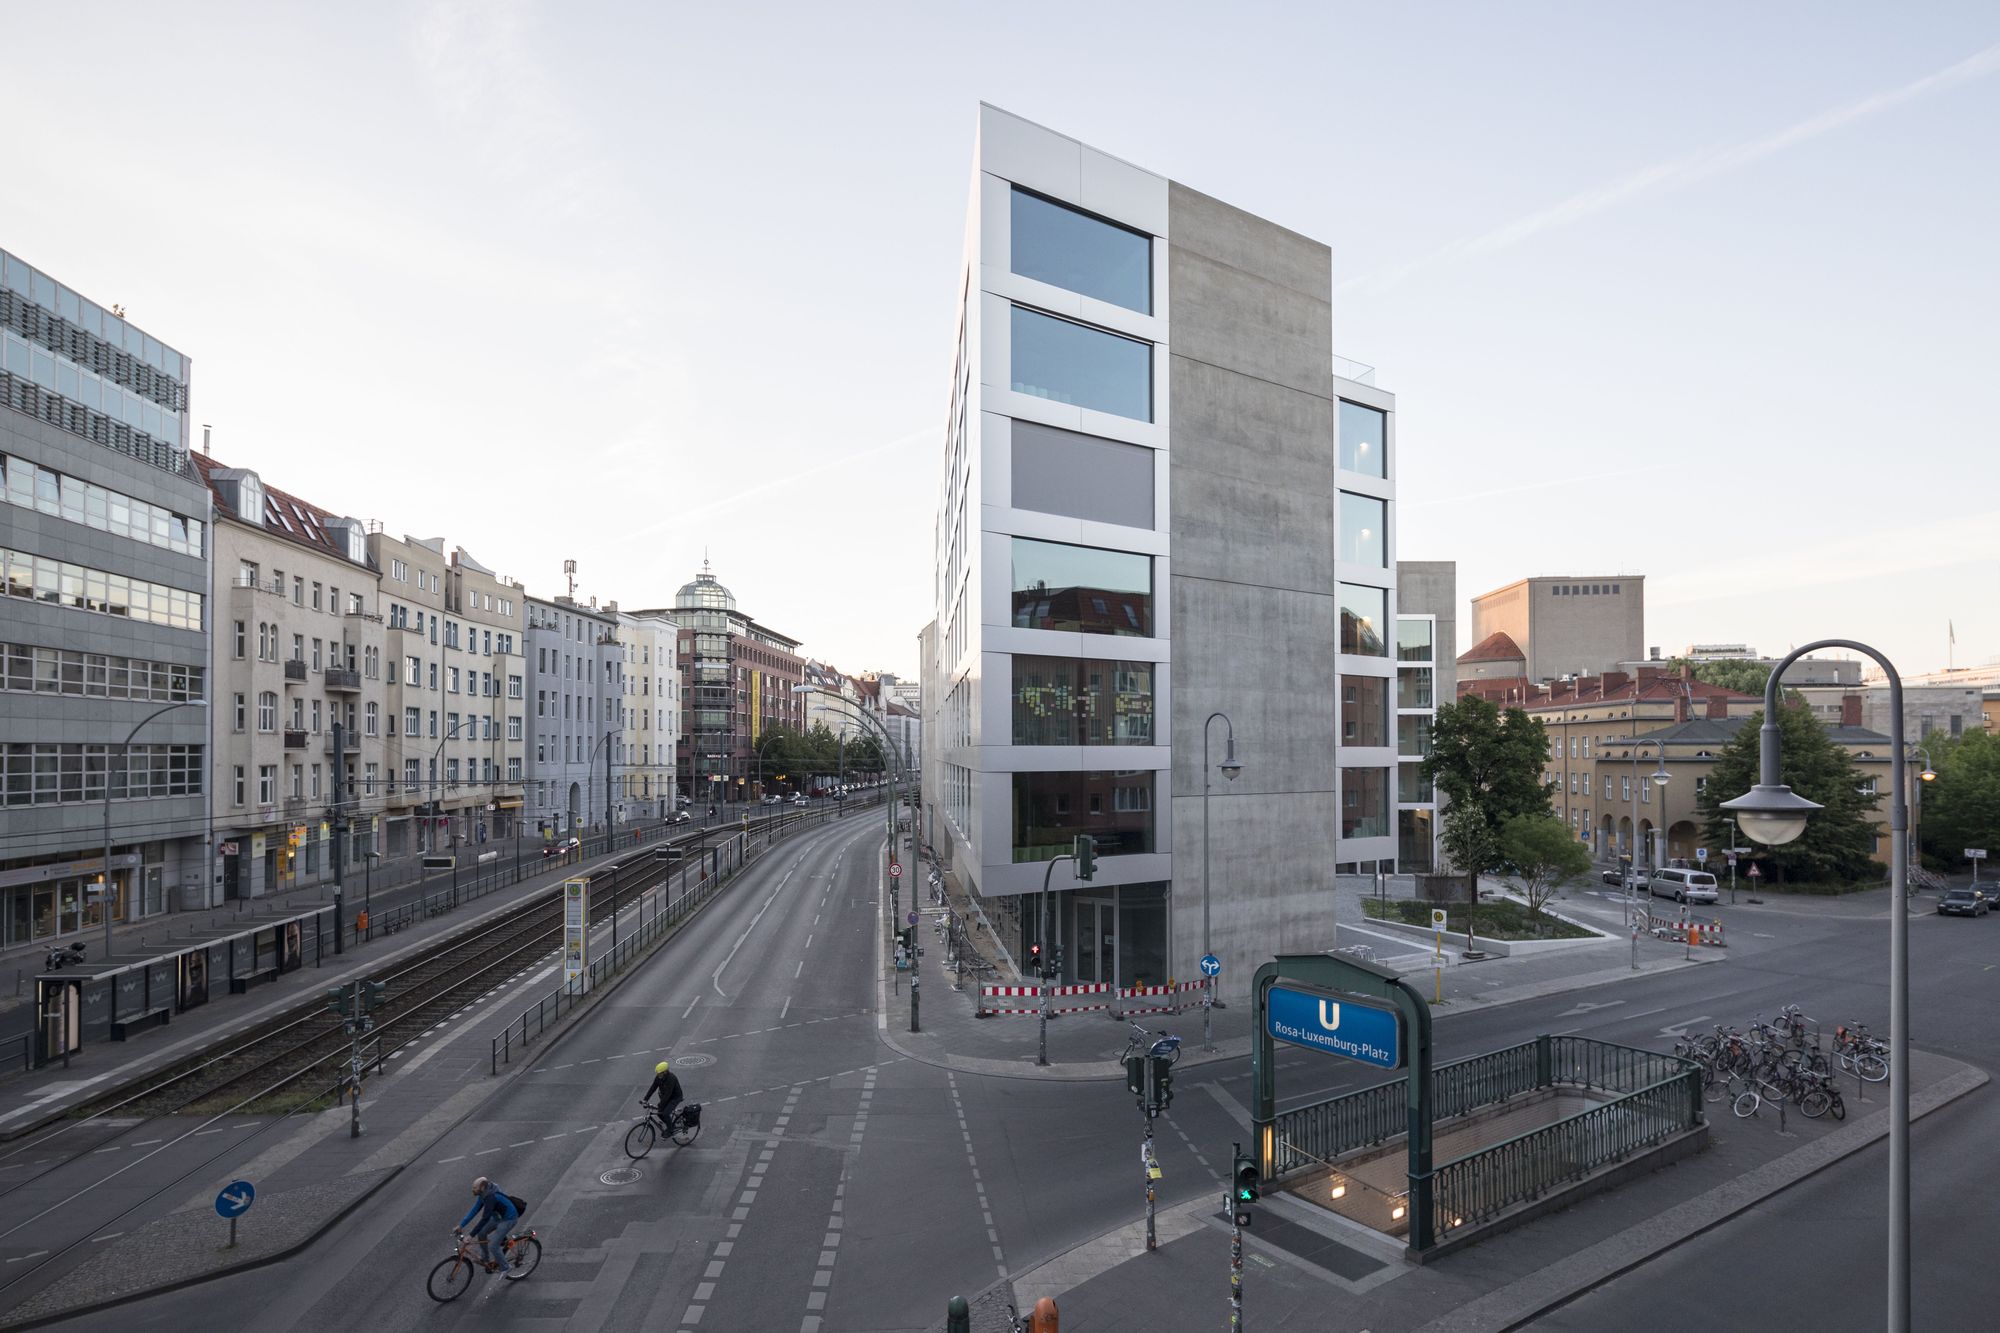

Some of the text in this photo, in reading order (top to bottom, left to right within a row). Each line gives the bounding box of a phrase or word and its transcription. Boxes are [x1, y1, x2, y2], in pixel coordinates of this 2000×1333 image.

[891, 866, 900, 874] 30
[1319, 999, 1340, 1031] U
[1275, 1021, 1389, 1061] Rosa-Luxemburg-Platz
